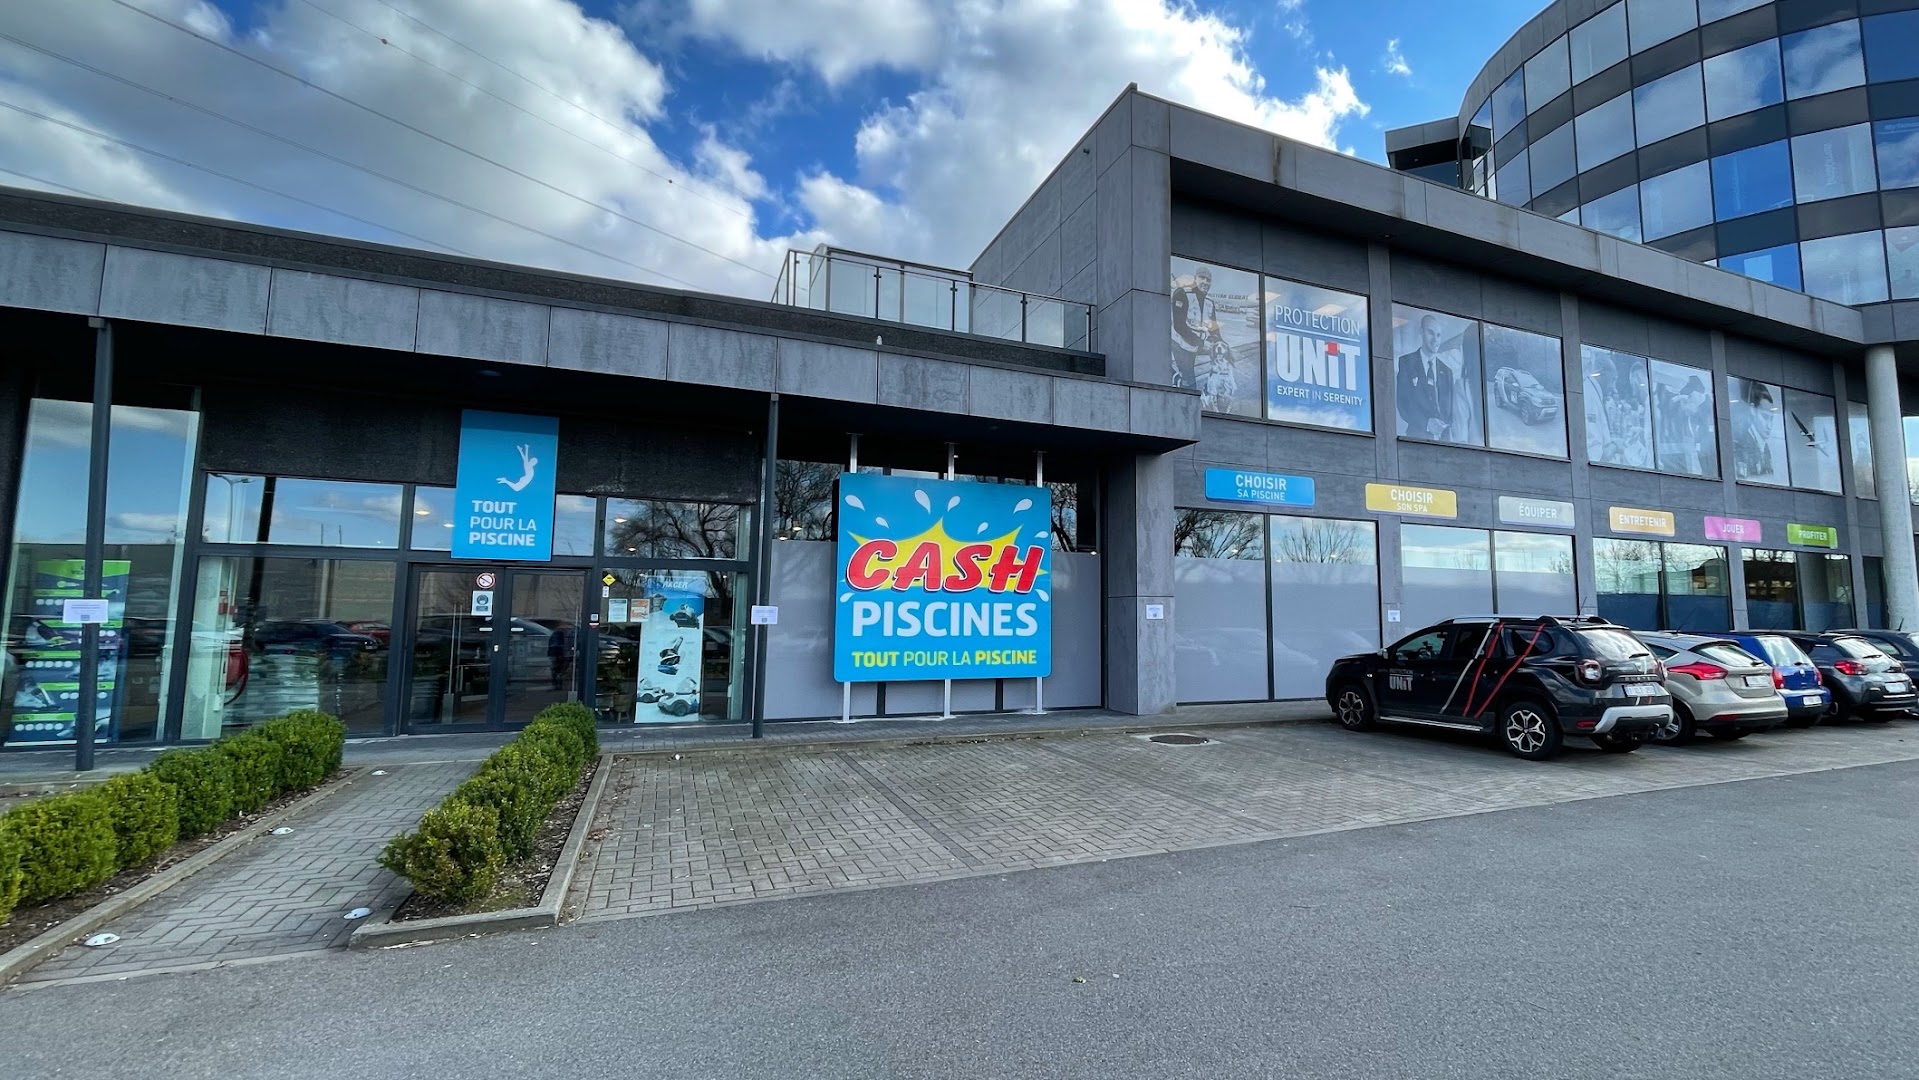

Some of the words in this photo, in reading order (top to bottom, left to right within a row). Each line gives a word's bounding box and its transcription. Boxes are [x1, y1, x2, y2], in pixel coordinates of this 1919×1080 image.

[1275, 304, 1360, 336] PROTECTION
[1277, 385, 1310, 399] EXPERT
[1311, 390, 1321, 400] IN
[1323, 392, 1363, 406] SERENITY
[1235, 474, 1287, 490] CHOISIR
[1237, 488, 1249, 498] SA
[1251, 490, 1286, 501] PISCINE
[1390, 489, 1433, 504] CHOISIR
[471, 499, 517, 514] TOUT
[1396, 502, 1412, 511] SON
[1413, 504, 1428, 512] SPA
[1518, 503, 1558, 519] ÉQUIPER
[469, 515, 515, 530] POUR
[518, 518, 537, 531] LA
[1619, 514, 1667, 528] ENTRETENIR
[1722, 523, 1744, 534] JOUER
[468, 531, 536, 547] PISCINE
[1798, 529, 1828, 541] PROFITER
[846, 539, 1045, 594] CASH
[852, 600, 1038, 637] PISCINES
[851, 651, 900, 668] TOUT
[903, 651, 948, 666] POUR
[952, 651, 971, 666] LA
[974, 650, 1037, 665] PISCINE
